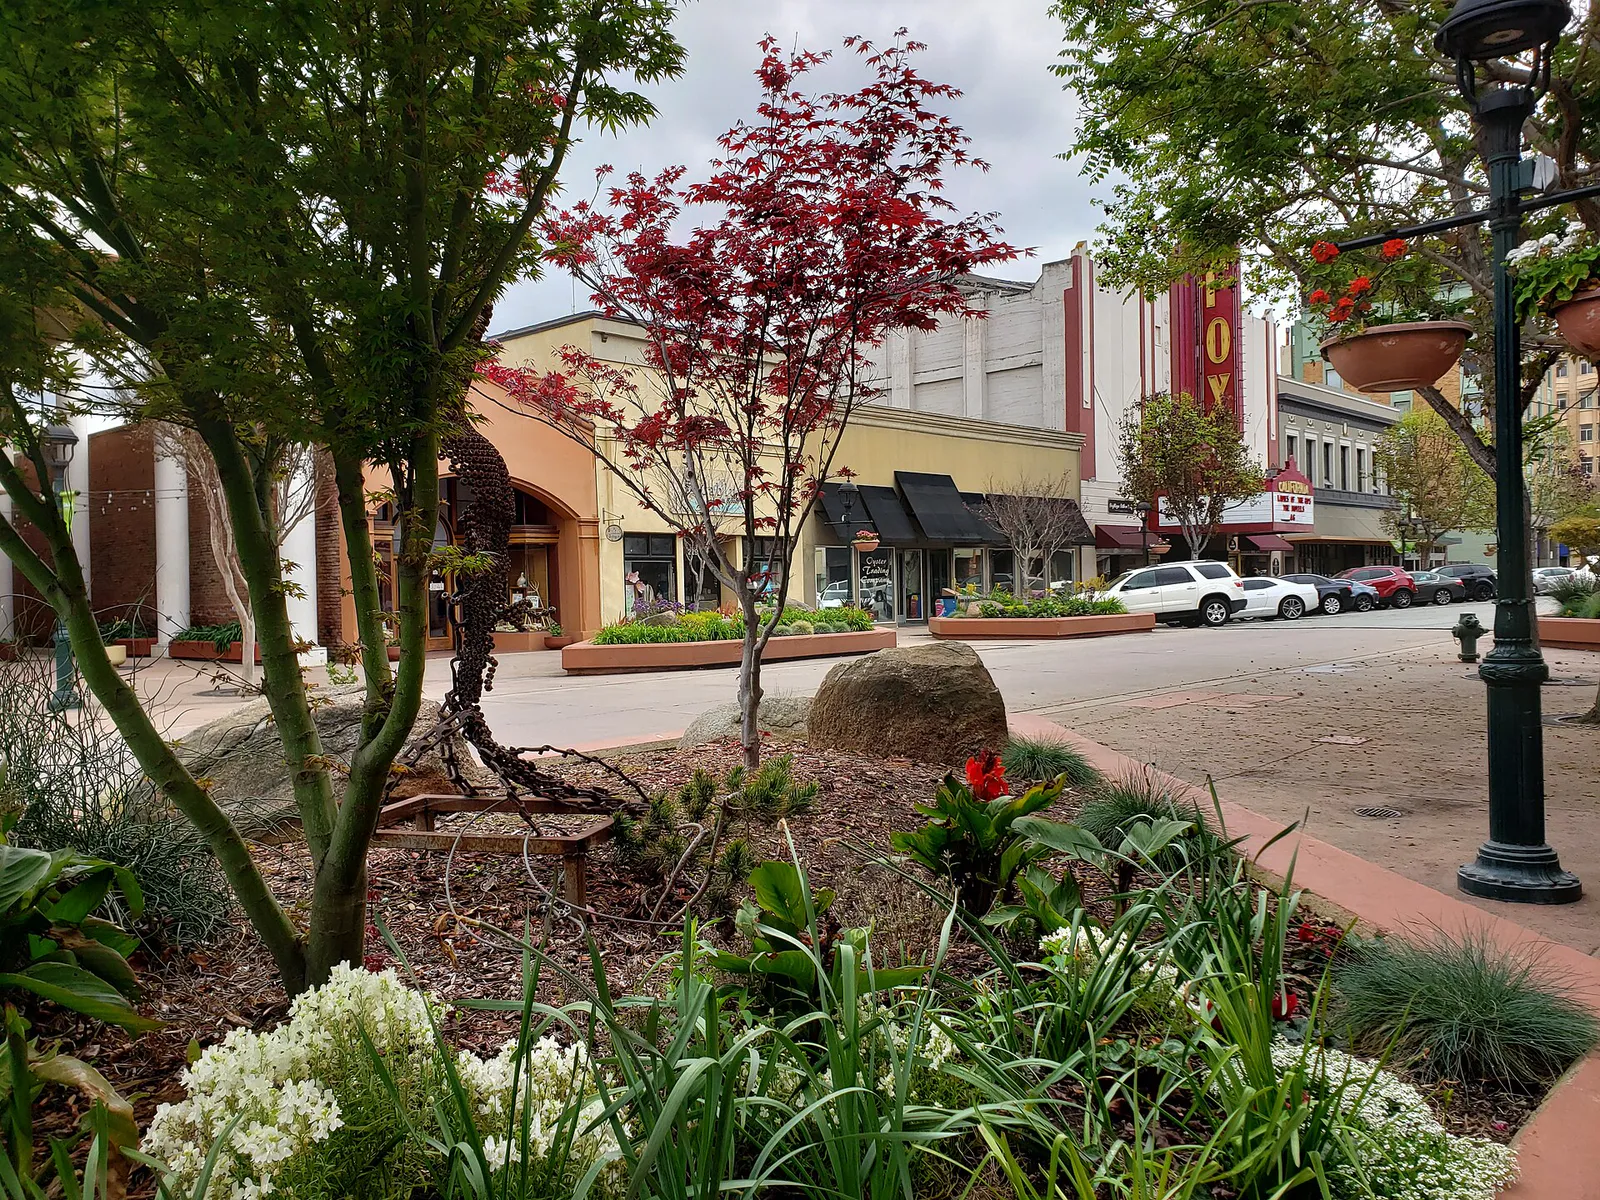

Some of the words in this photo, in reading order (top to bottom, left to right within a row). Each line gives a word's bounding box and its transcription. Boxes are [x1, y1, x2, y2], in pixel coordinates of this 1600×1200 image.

[1279, 480, 1309, 494] CALIFORNIA
[866, 556, 887, 567] Oyster
[862, 565, 889, 576] Trading
[860, 575, 891, 587] Company
